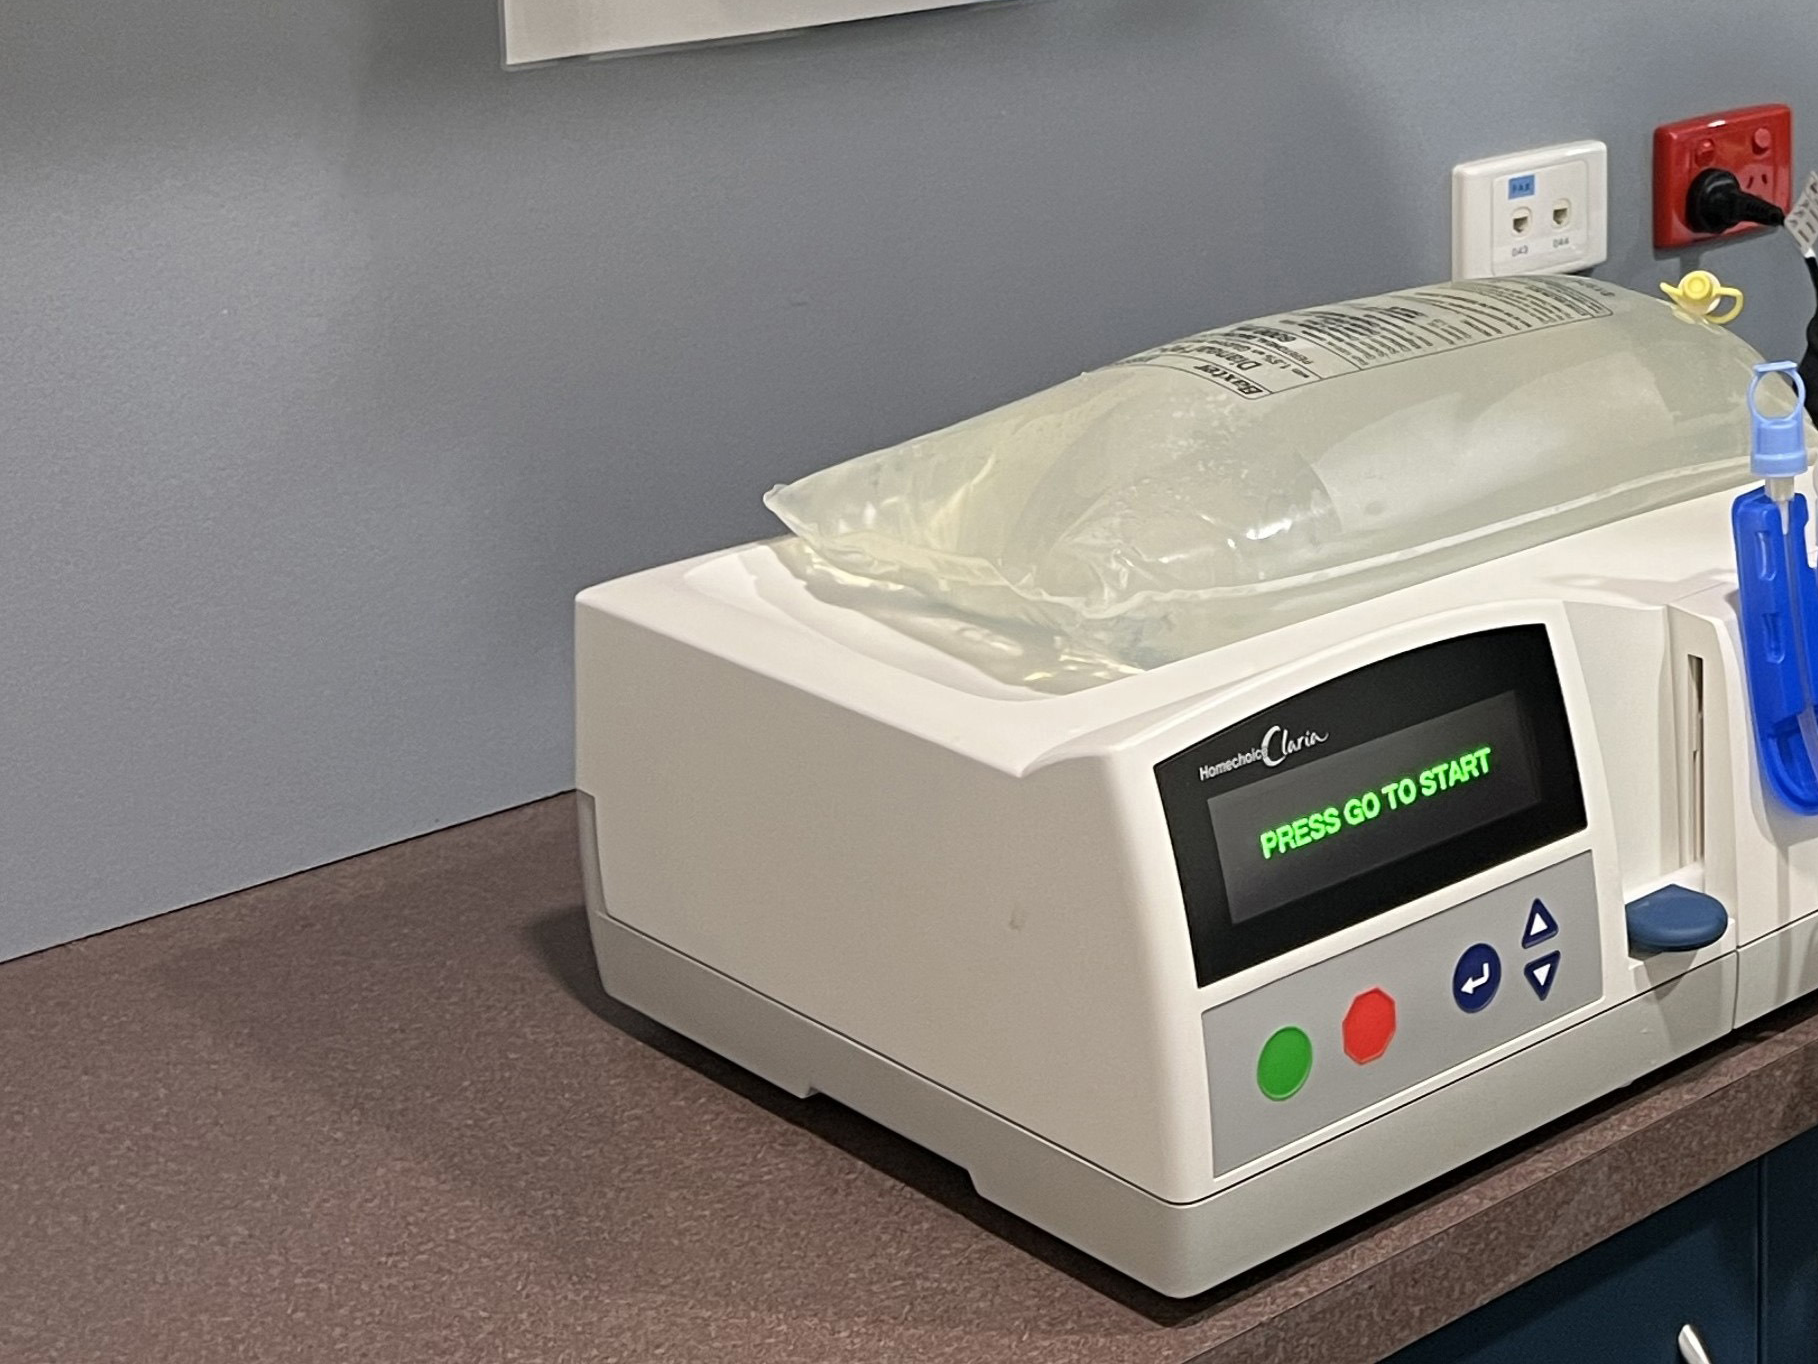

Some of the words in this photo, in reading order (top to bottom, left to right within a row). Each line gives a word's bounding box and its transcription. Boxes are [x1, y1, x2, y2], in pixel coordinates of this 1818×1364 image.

[1193, 363, 1264, 395] Baxter
[1199, 744, 1268, 781] Homechoice
[1261, 725, 1330, 768] Claria
[1259, 806, 1342, 860] PRESS
[1343, 791, 1381, 826] GO
[1381, 777, 1417, 810] TO
[1418, 746, 1492, 797] START
